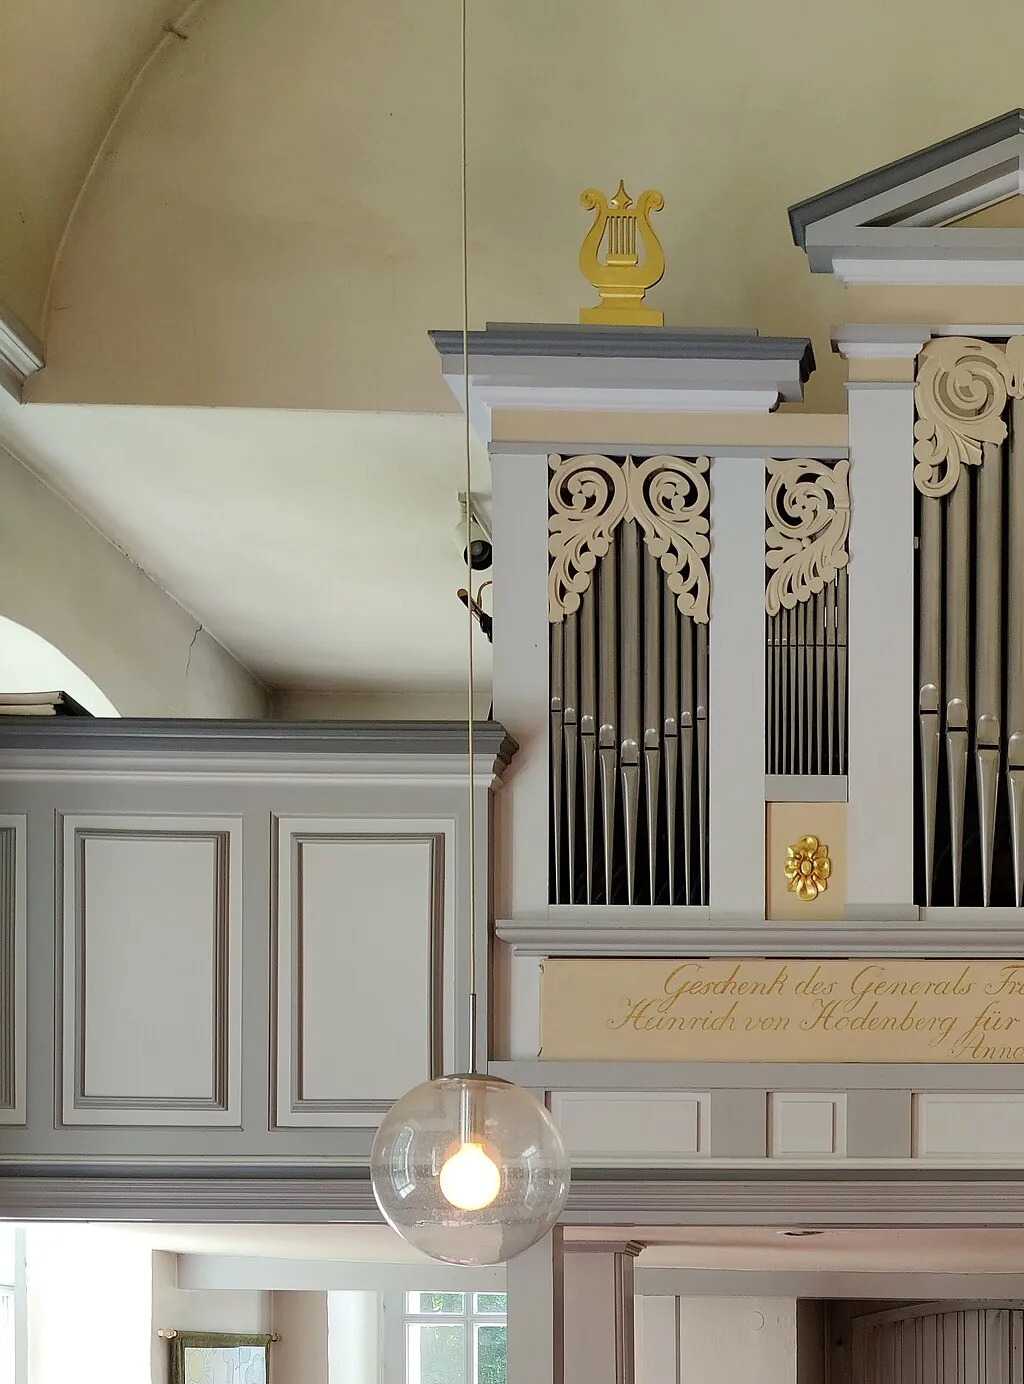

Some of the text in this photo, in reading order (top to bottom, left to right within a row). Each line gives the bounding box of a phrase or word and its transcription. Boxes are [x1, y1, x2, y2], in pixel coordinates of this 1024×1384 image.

[658, 963, 788, 1012] Geschenk
[795, 965, 838, 996] des
[843, 965, 976, 1013] Generals
[605, 998, 738, 1031] Heinrich
[744, 1014, 790, 1031] von
[799, 998, 958, 1048] Hodenberg
[953, 999, 1021, 1047] für
